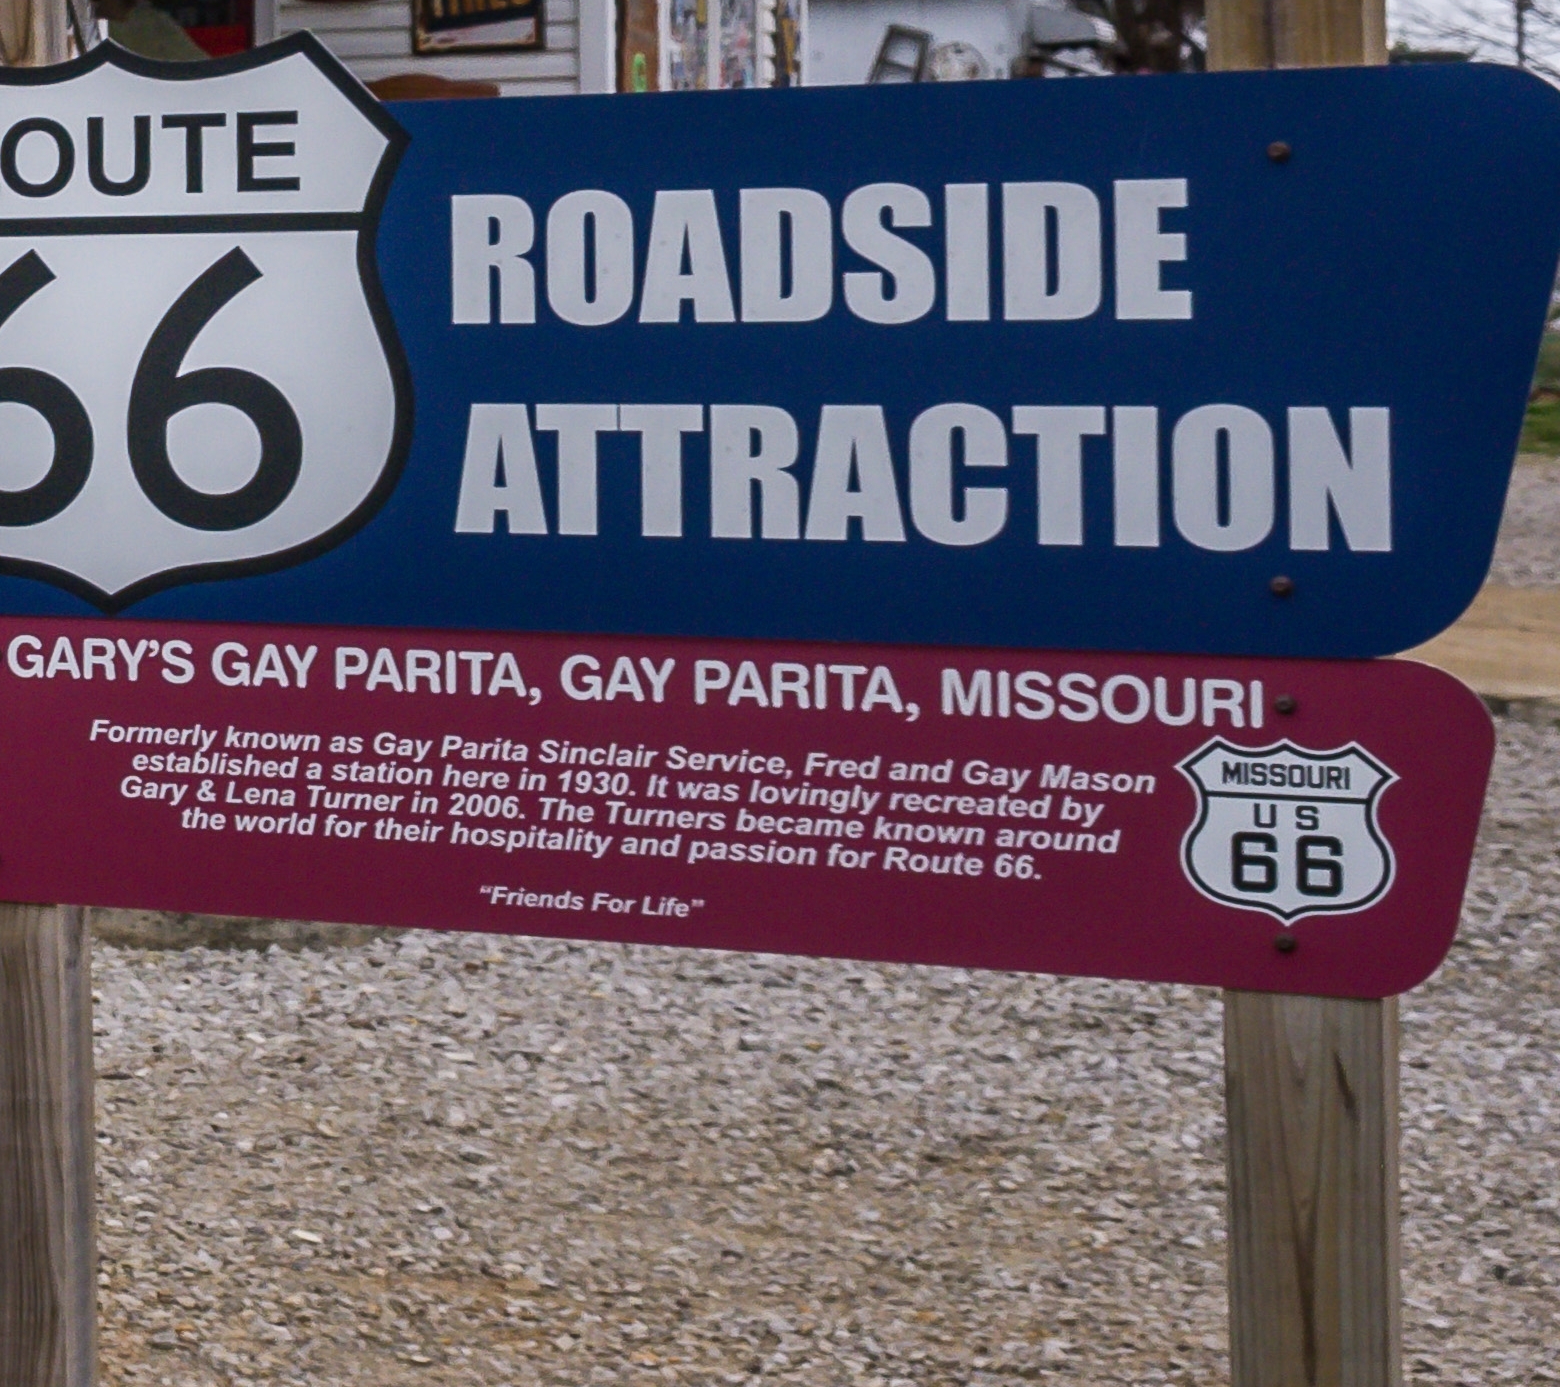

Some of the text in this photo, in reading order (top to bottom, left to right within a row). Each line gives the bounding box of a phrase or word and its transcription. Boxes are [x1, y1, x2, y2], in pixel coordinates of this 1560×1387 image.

[450, 177, 1194, 327] ROADSIDE
[453, 402, 1393, 552] ATTRACTION
[6, 634, 1264, 729] GARY'S GAY PARITA, GAY PARITA, MISSOURI
[89, 719, 1156, 795] Formerly known as Gay Parita Sinclair Service, Fred and Gay Mason
[132, 750, 1105, 826] established a station here in 1930. It was lovingly recreated by
[1222, 760, 1351, 790] MISSOURI
[120, 775, 1122, 854] Gary & Lena Turner in 2006. The Turners became known around
[181, 806, 1042, 880] the world for their hospitality and passion for Route 66.
[1253, 802, 1320, 831] U S
[590, 892, 636, 914] For
[1230, 831, 1344, 899] 66
